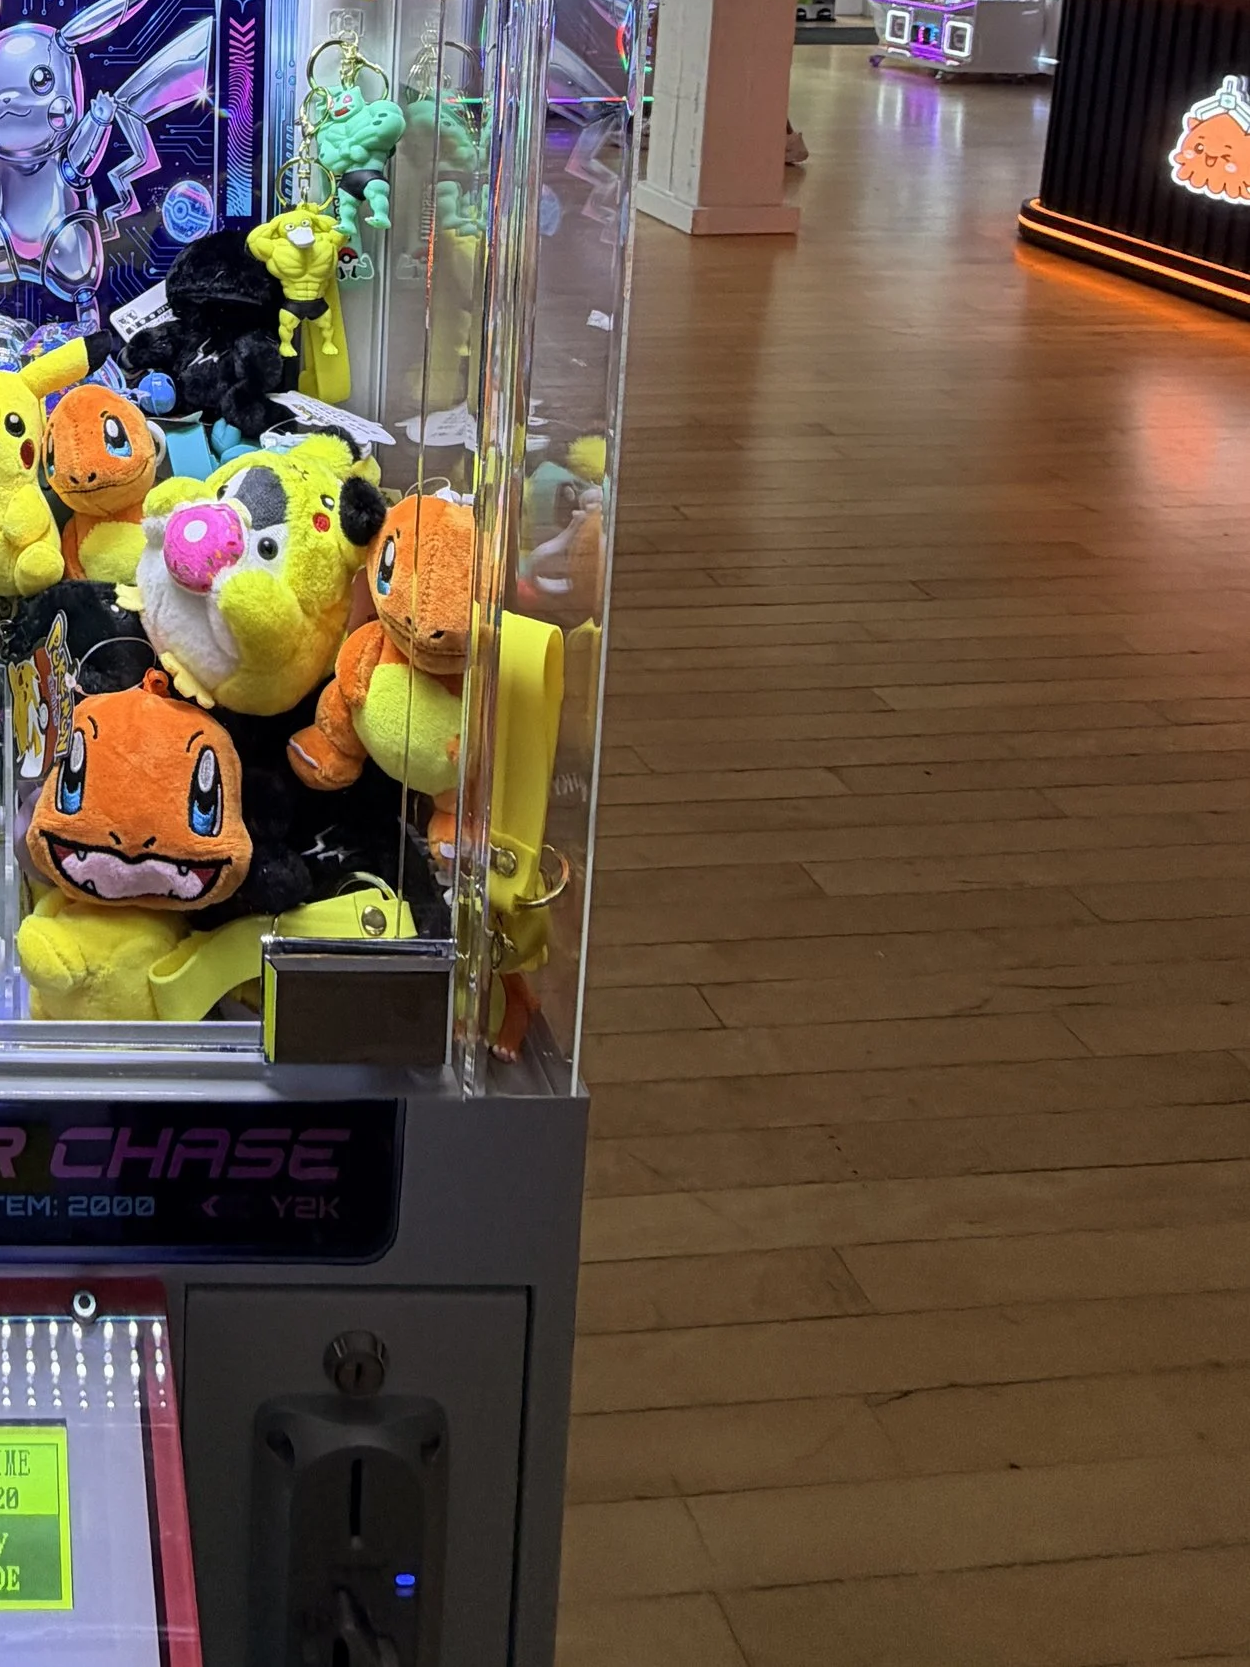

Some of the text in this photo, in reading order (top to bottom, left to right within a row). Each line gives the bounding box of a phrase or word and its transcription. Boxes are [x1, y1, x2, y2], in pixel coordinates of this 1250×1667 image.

[50, 1126, 350, 1181] CHASE
[68, 1195, 155, 1217] 2000
[271, 1195, 340, 1219] Y2K
